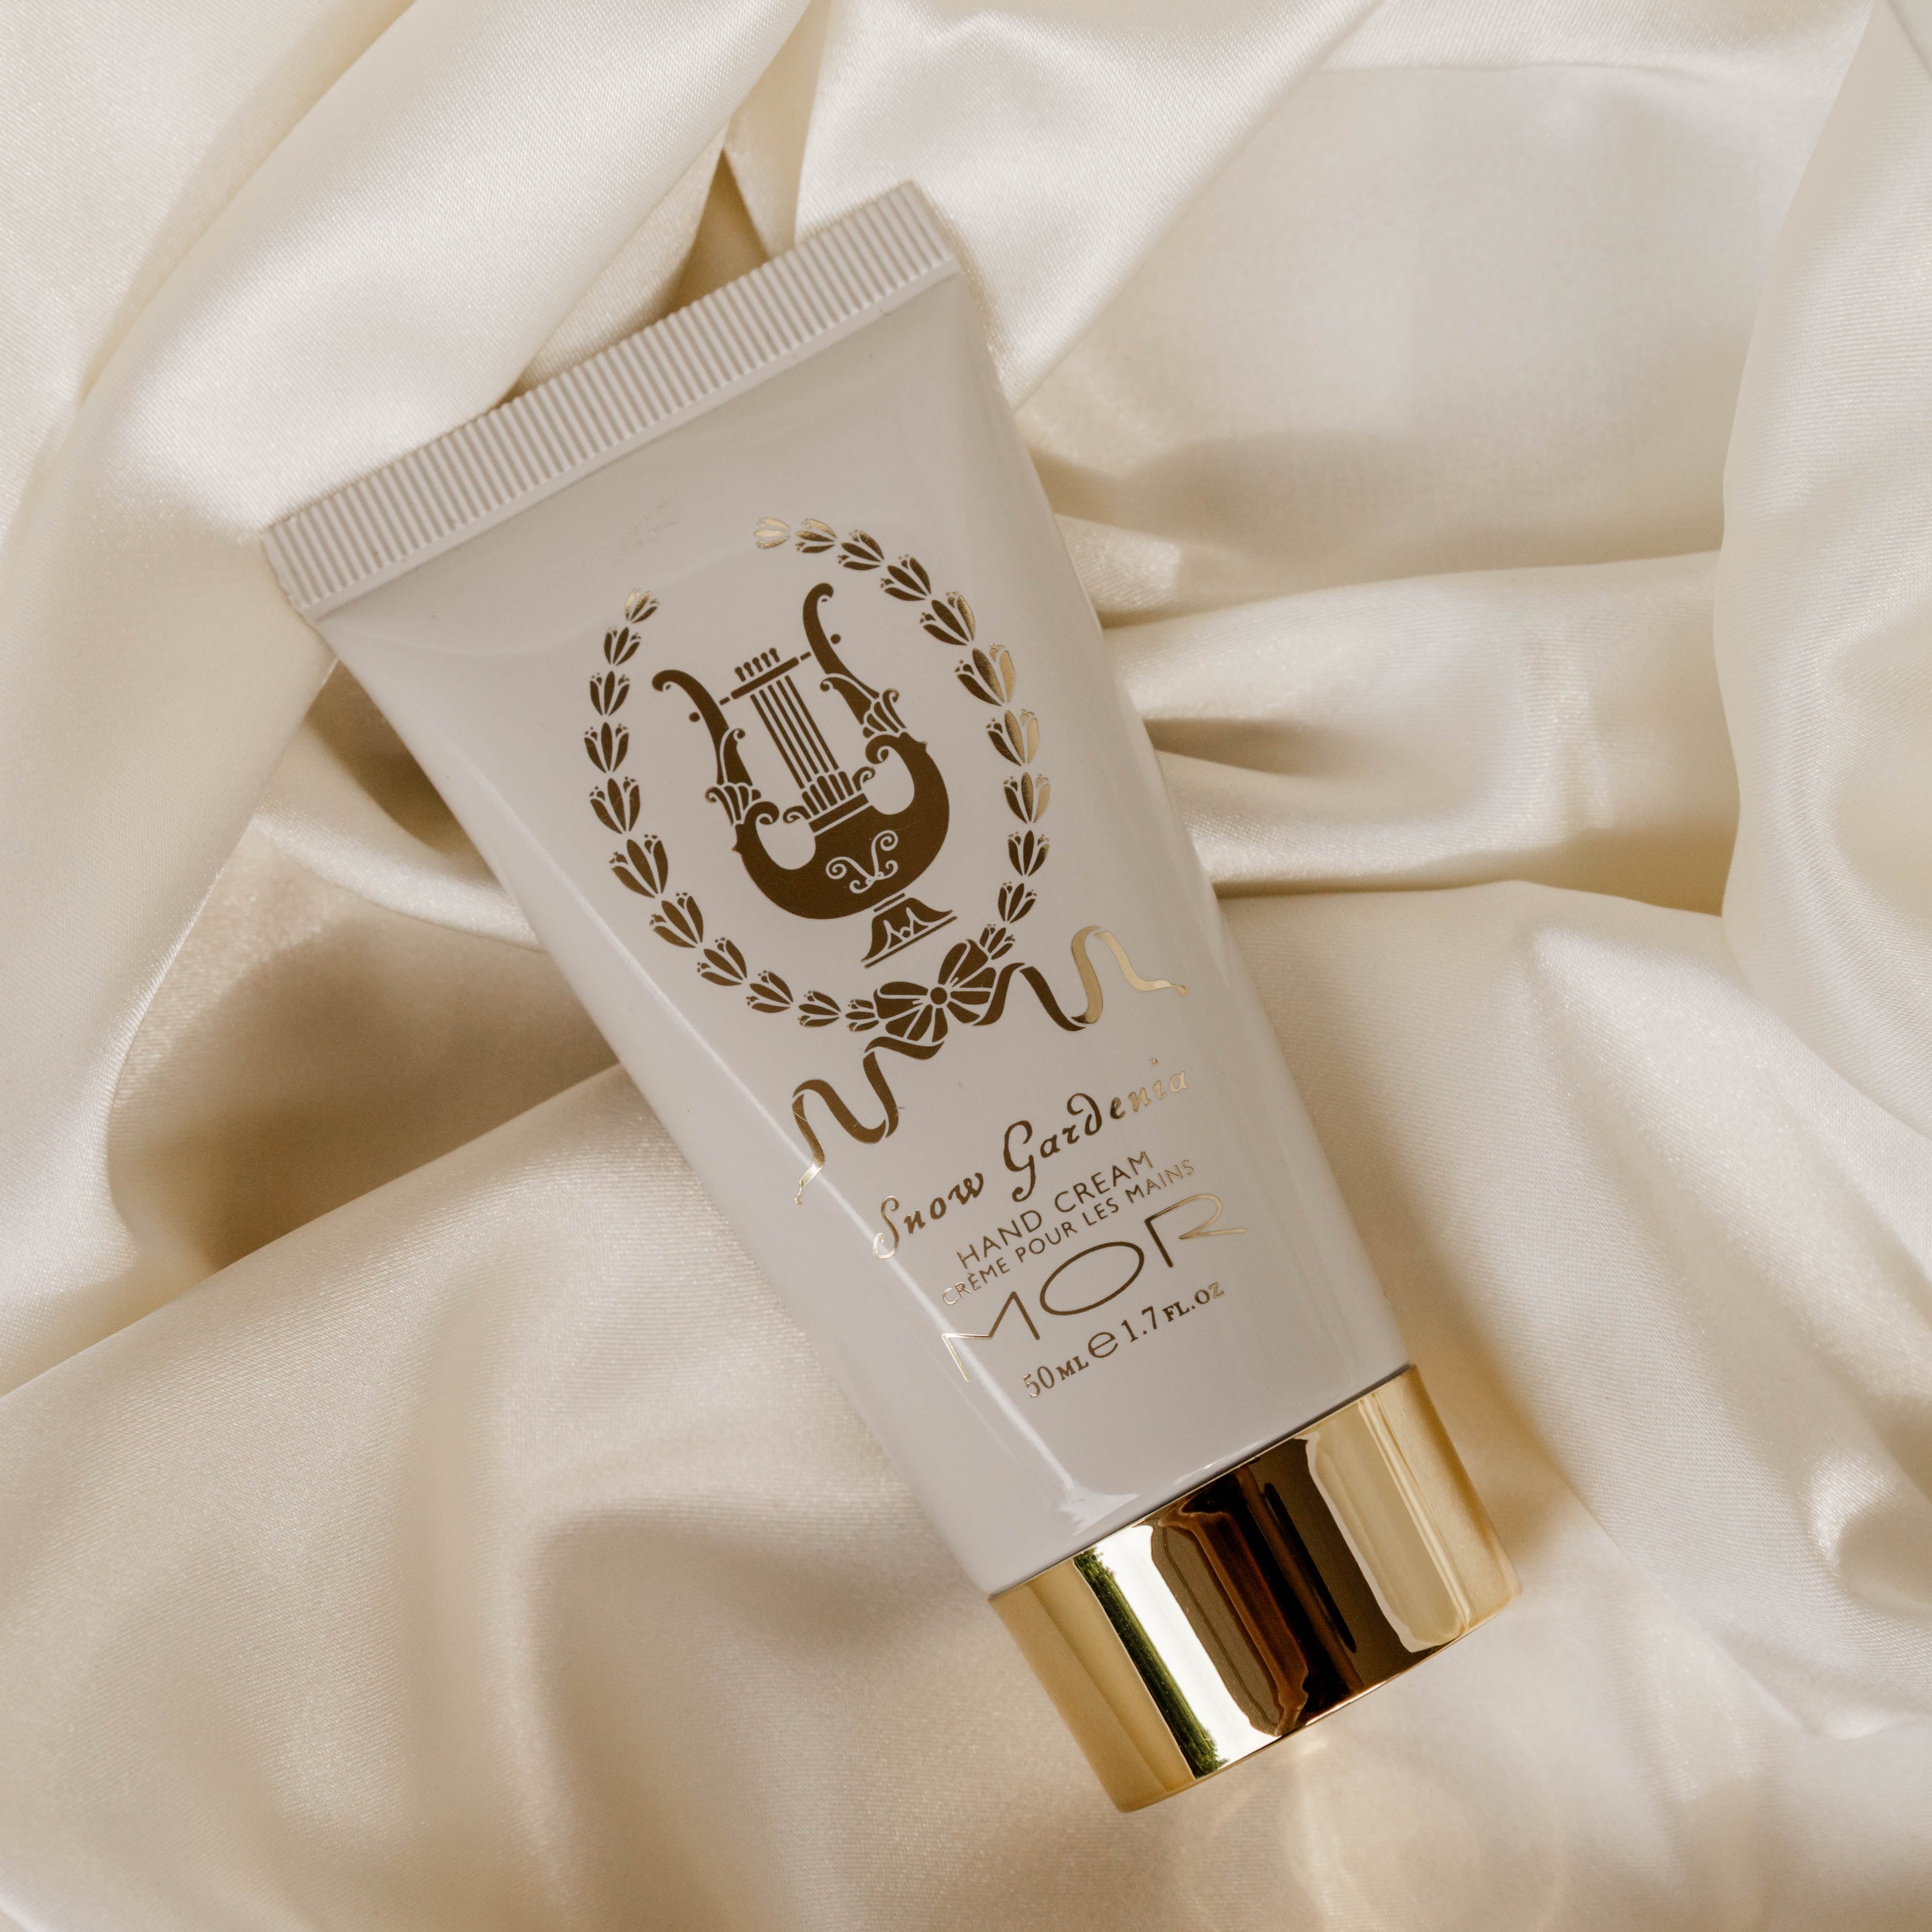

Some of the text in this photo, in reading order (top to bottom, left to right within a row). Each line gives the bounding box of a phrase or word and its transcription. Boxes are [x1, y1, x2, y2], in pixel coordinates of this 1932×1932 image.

[873, 1058, 1188, 1258] Snow Gardenia
[942, 1160, 1194, 1305] CRÈME POUR LES MAINS
[957, 1151, 1153, 1269] HAND CREAM
[942, 1193, 1247, 1382] MOR
